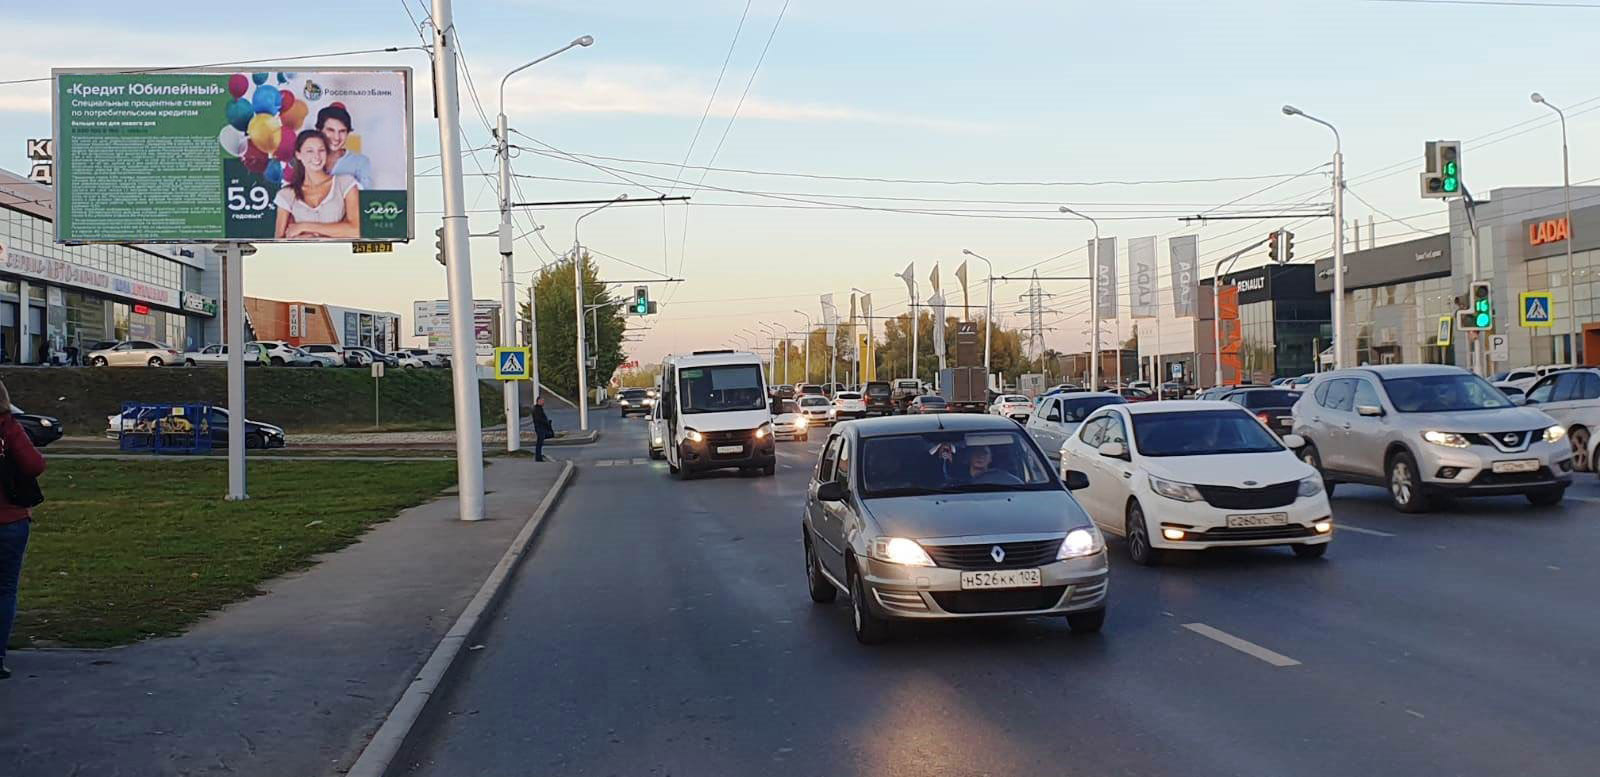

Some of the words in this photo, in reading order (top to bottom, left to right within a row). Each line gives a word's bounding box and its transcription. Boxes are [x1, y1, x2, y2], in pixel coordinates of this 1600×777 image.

[66, 83, 125, 97] «Кредит
[128, 83, 225, 96] Юбилейный»
[324, 88, 392, 97] РоссельхозБанк
[71, 99, 129, 107] Специальные
[131, 100, 182, 108] процентные
[84, 109, 157, 117] потребительским
[1530, 218, 1569, 245] LADA
[1237, 277, 1265, 292] RENAULT
[1493, 337, 1504, 350] P
[1020, 570, 1037, 581] 102
